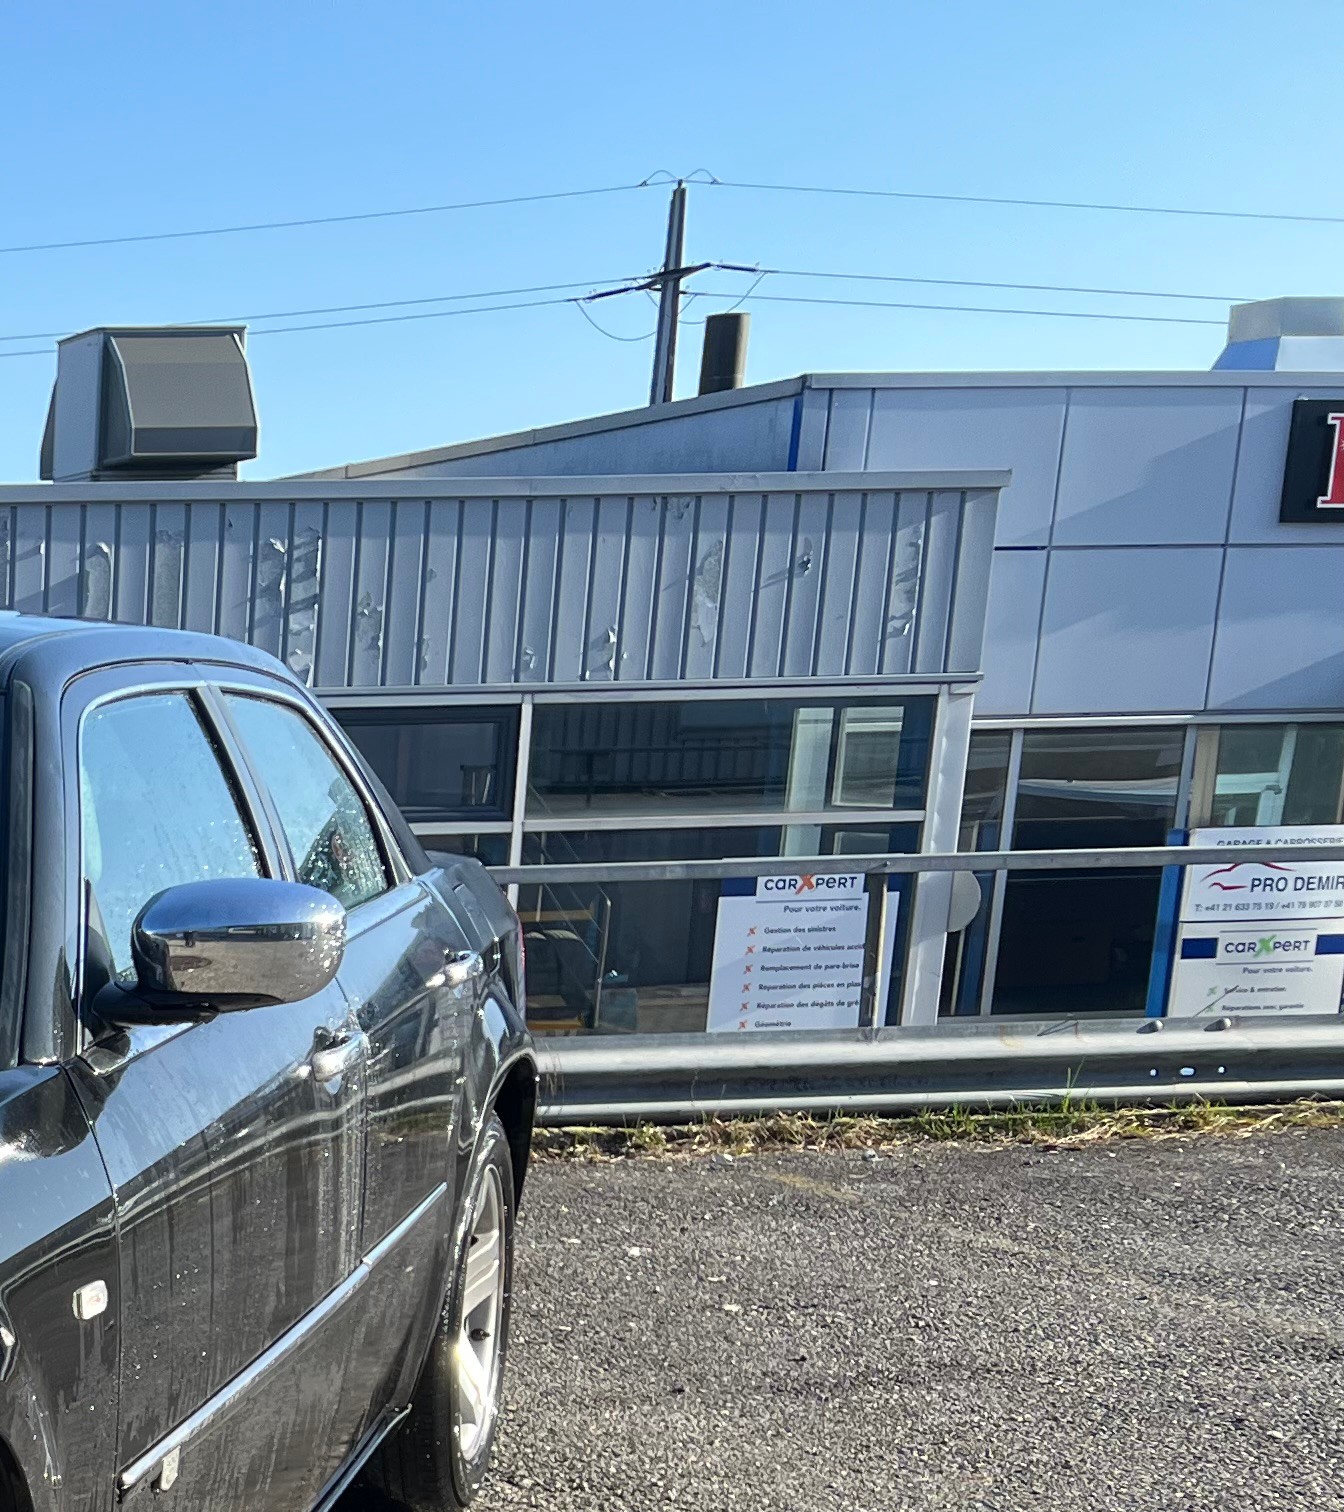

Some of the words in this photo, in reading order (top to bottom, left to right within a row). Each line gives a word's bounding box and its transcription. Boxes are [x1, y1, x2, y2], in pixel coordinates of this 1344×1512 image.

[1250, 877, 1287, 893] PRO
[784, 905, 803, 914] Pour
[804, 905, 828, 913] votre
